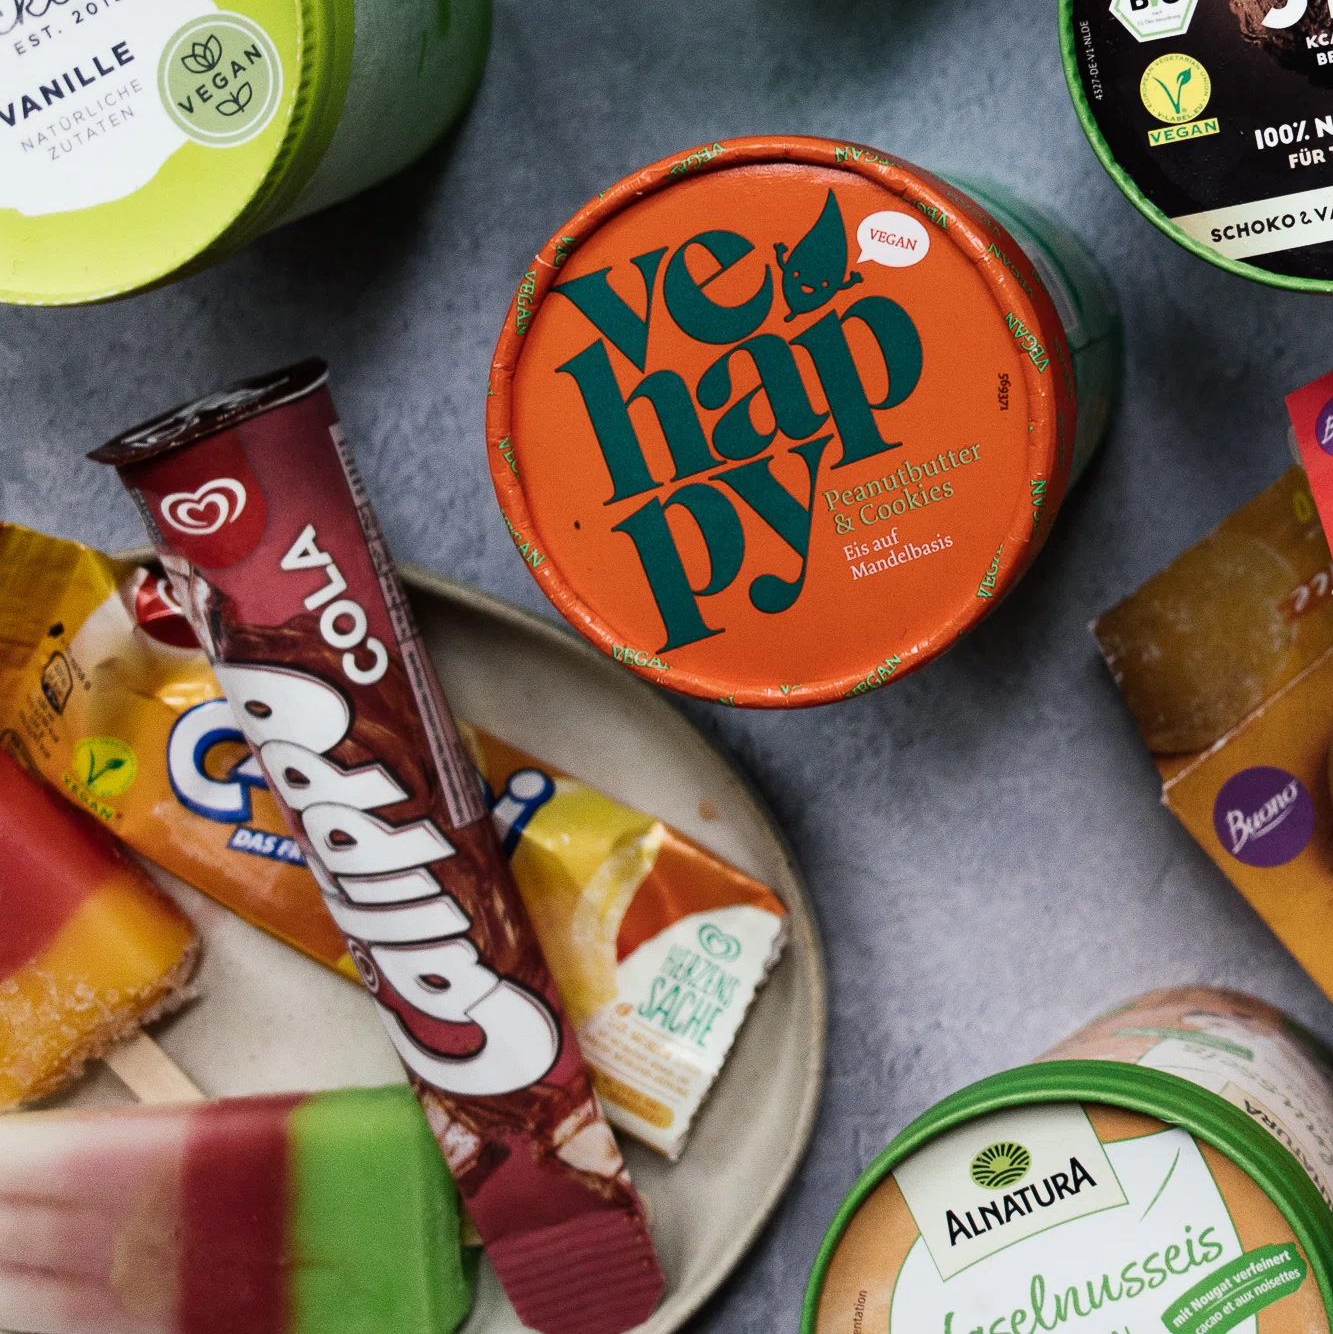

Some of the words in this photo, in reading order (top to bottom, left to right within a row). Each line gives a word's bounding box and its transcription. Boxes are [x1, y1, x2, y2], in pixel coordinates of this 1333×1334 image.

[14, 21, 63, 56] EST.
[178, 43, 263, 115] VEGAN
[869, 227, 919, 252] VEGAN
[1209, 211, 1296, 244] SCHOKO
[823, 442, 983, 512] Peanutbutter
[833, 515, 856, 536] &
[857, 479, 955, 530] Cookies
[843, 539, 868, 561] Eis
[871, 528, 900, 553] auf
[850, 532, 954, 582] Mandelbasis
[279, 524, 389, 687] COLA
[944, 1155, 1098, 1247] ALNATURA
[1172, 1306, 1197, 1329] mit
[1190, 1274, 1235, 1313] Nougat
[1231, 1247, 1293, 1289] verfeinert
